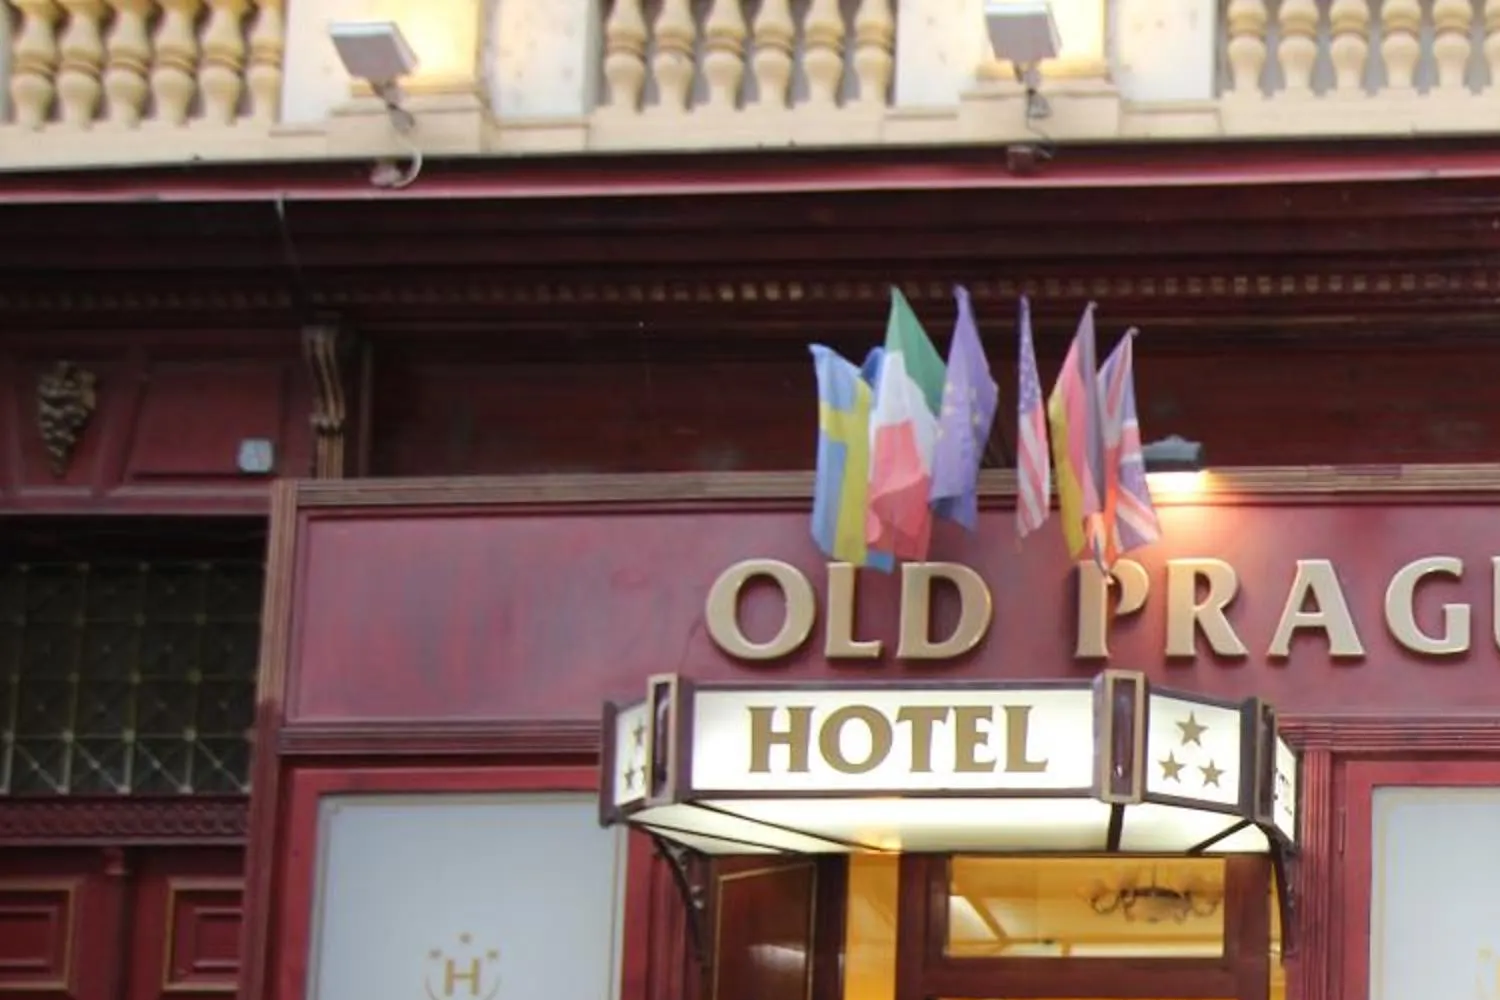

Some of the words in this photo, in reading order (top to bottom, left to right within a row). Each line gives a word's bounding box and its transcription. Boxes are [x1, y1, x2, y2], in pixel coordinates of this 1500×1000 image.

[705, 558, 993, 660] OLD
[746, 704, 1049, 774] HOTEL
[444, 957, 481, 997] H
